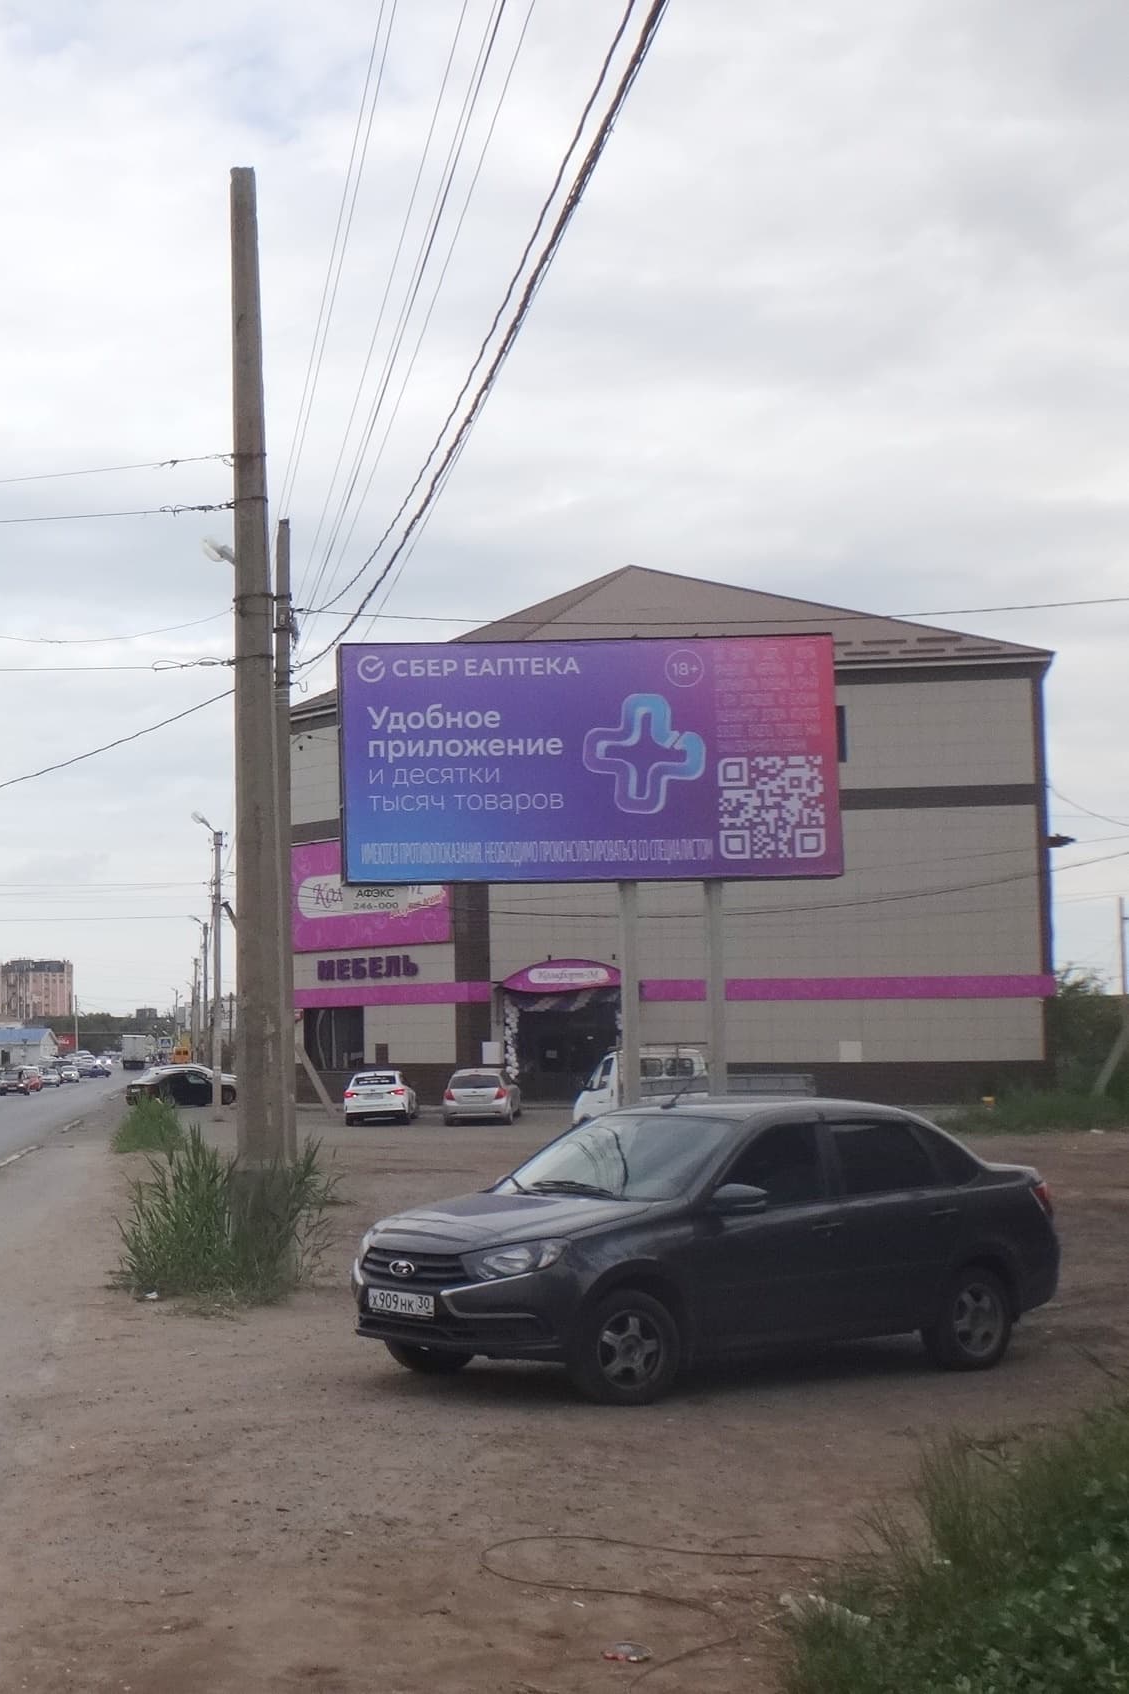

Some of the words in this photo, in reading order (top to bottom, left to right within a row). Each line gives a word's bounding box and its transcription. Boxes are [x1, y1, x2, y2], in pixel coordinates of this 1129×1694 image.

[392, 658, 458, 678] СБЕР
[464, 656, 580, 677] ЕАПТЕКА
[672, 663, 699, 676] 18+
[367, 703, 501, 733] Удобное
[368, 736, 564, 764] приложение
[369, 768, 385, 785] и
[392, 766, 501, 788] десятки
[369, 794, 445, 812] тысяч
[454, 792, 564, 815] товаров
[356, 888, 395, 899] АФЭКС
[353, 902, 399, 910] 246-000
[317, 955, 420, 982] МЕБЕЛЬ
